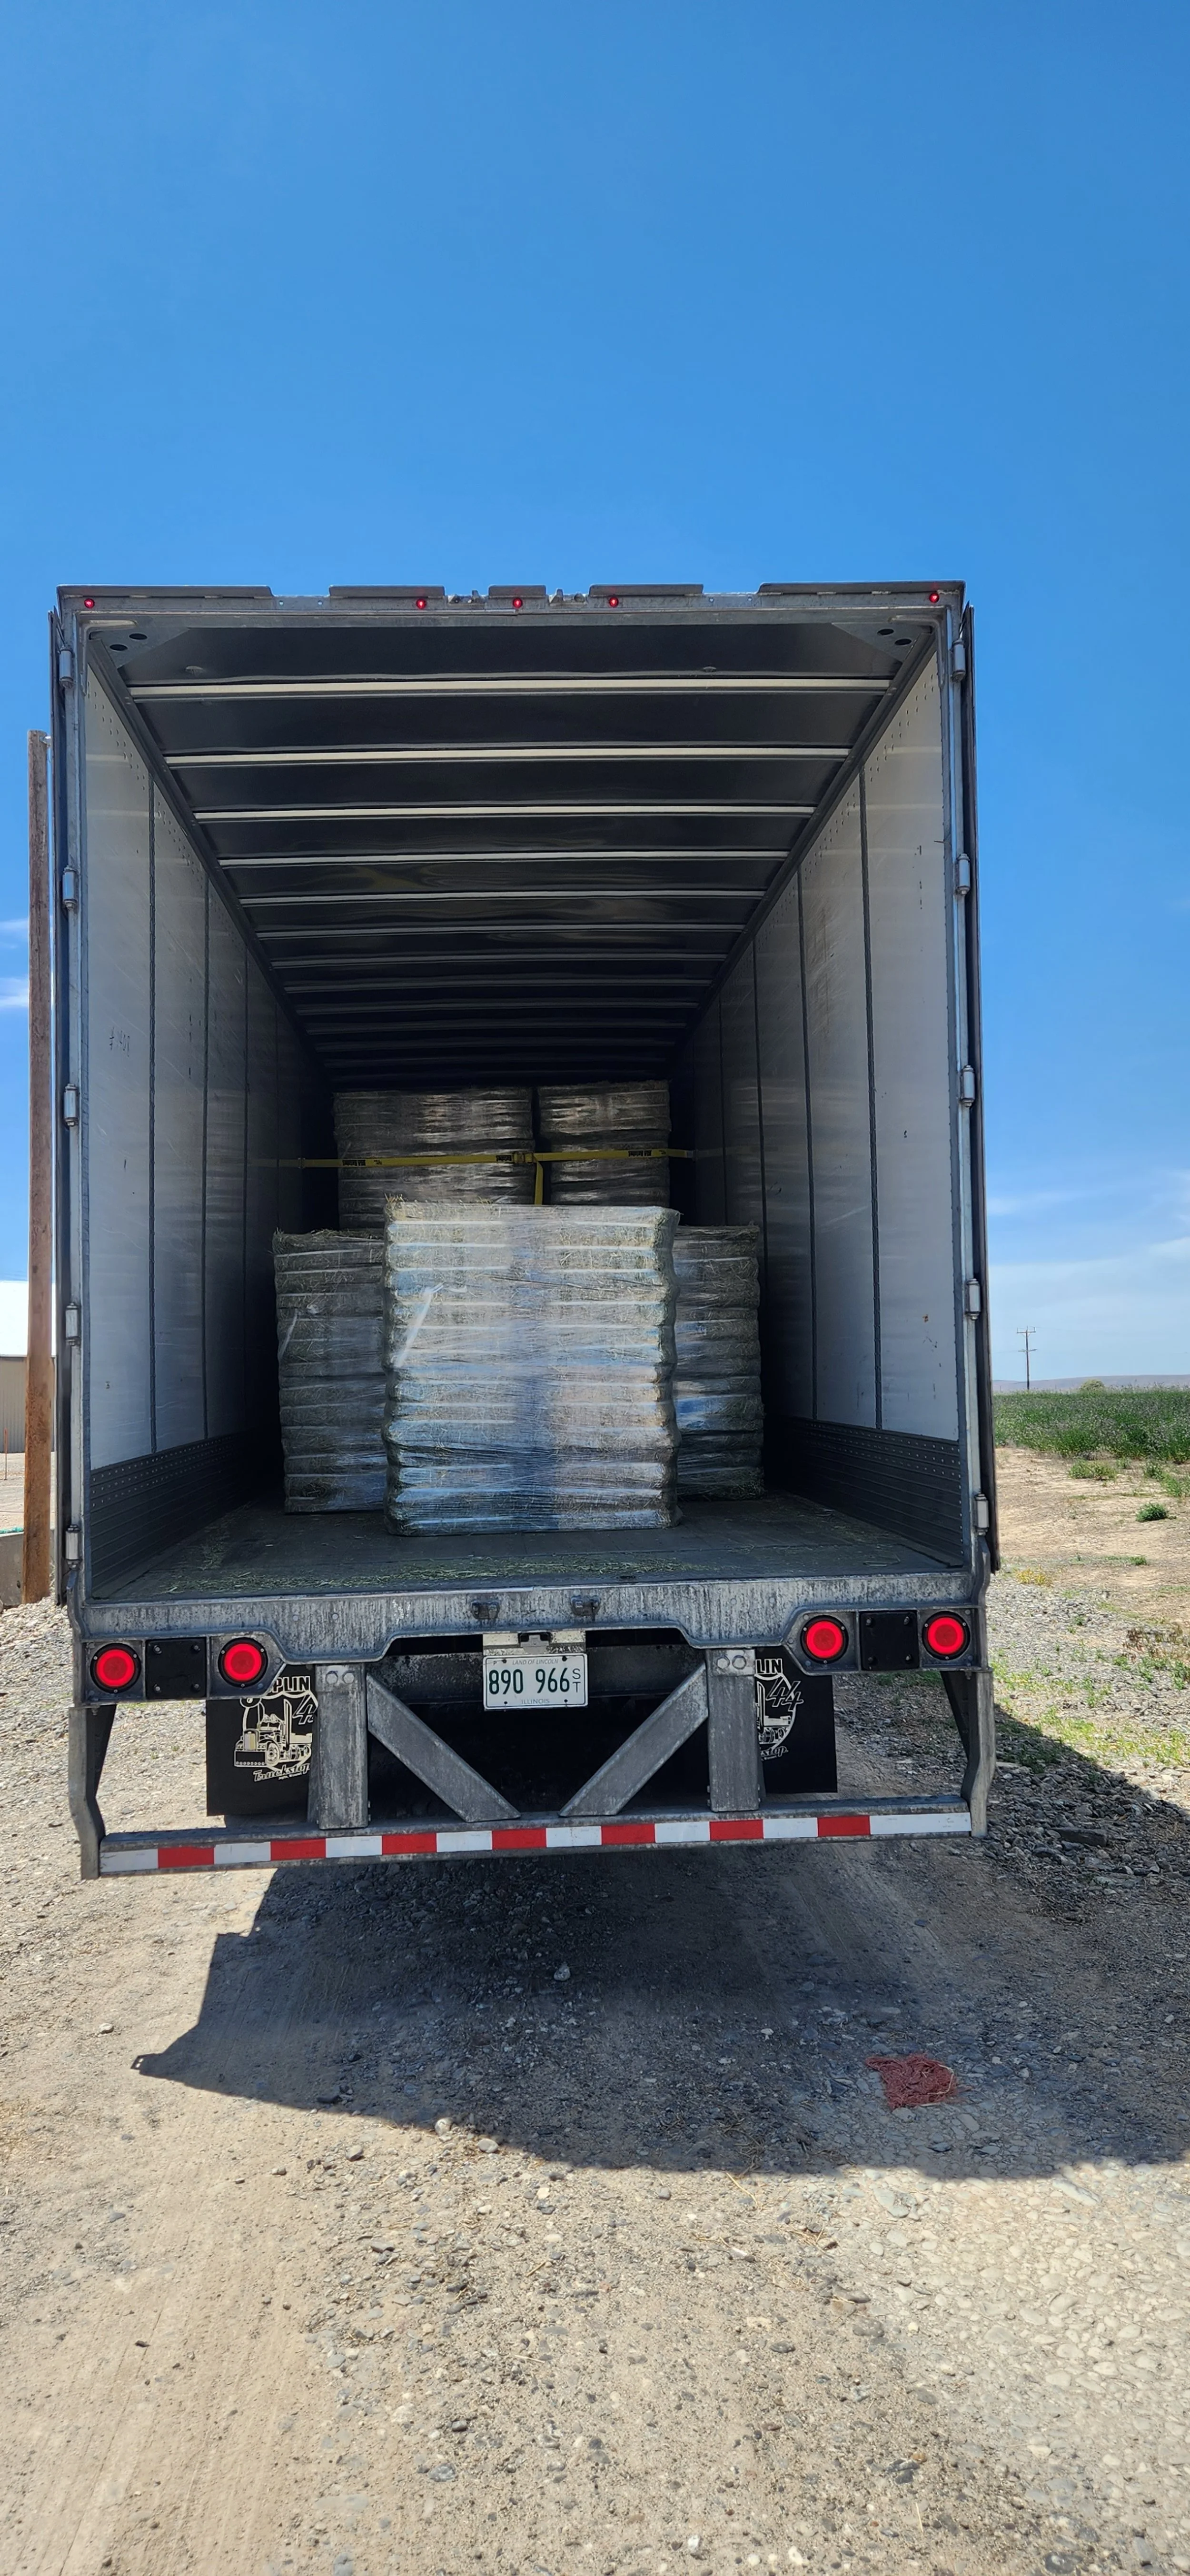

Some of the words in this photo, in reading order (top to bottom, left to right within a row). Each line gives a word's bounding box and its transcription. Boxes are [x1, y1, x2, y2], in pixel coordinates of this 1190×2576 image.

[268, 1675, 310, 1694] PLIN
[488, 1669, 524, 1695] 890
[536, 1667, 570, 1693] 966
